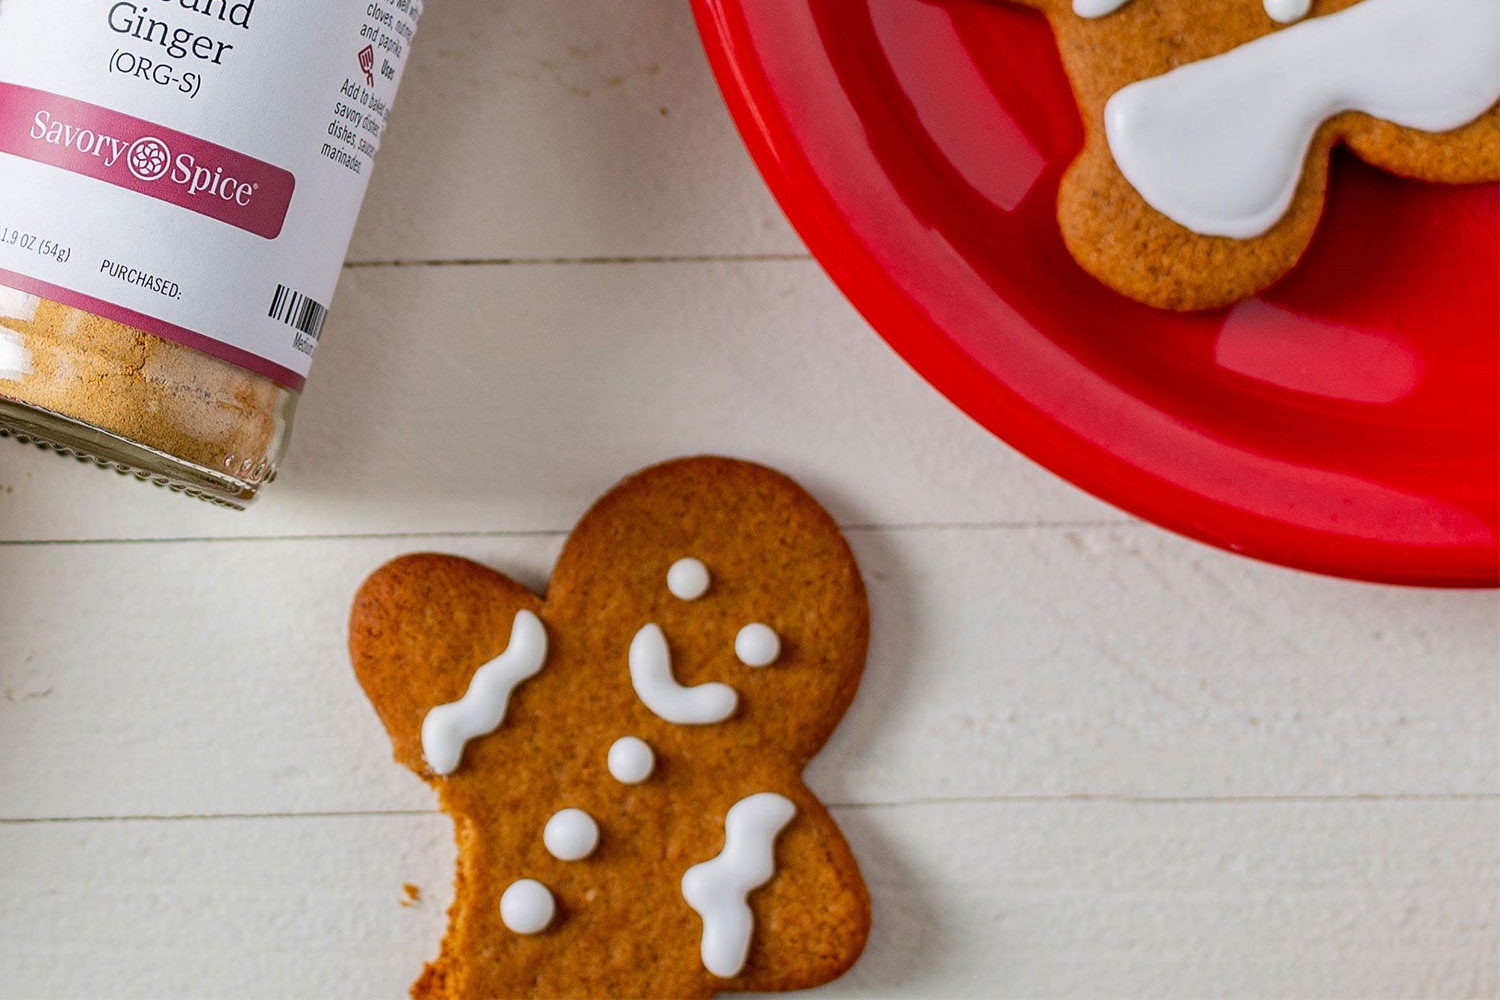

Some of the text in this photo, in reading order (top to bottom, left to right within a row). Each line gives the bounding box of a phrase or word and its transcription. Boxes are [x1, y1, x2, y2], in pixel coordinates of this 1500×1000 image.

[366, 2, 394, 30] cloves,
[108, 2, 234, 65] Ginger
[360, 24, 380, 42] and
[109, 48, 201, 98] (ORG-S)
[381, 58, 395, 80] Uses
[340, 78, 360, 100] Add
[360, 88, 368, 106] to
[334, 102, 363, 128] savory
[30, 110, 129, 167] Savory
[327, 119, 356, 149] dishes,
[321, 142, 362, 174] marinades.
[0, 228, 18, 245] 1.9
[20, 234, 37, 250] OZ
[38, 239, 71, 263] (54g)
[100, 259, 182, 300] PURCHASED:
